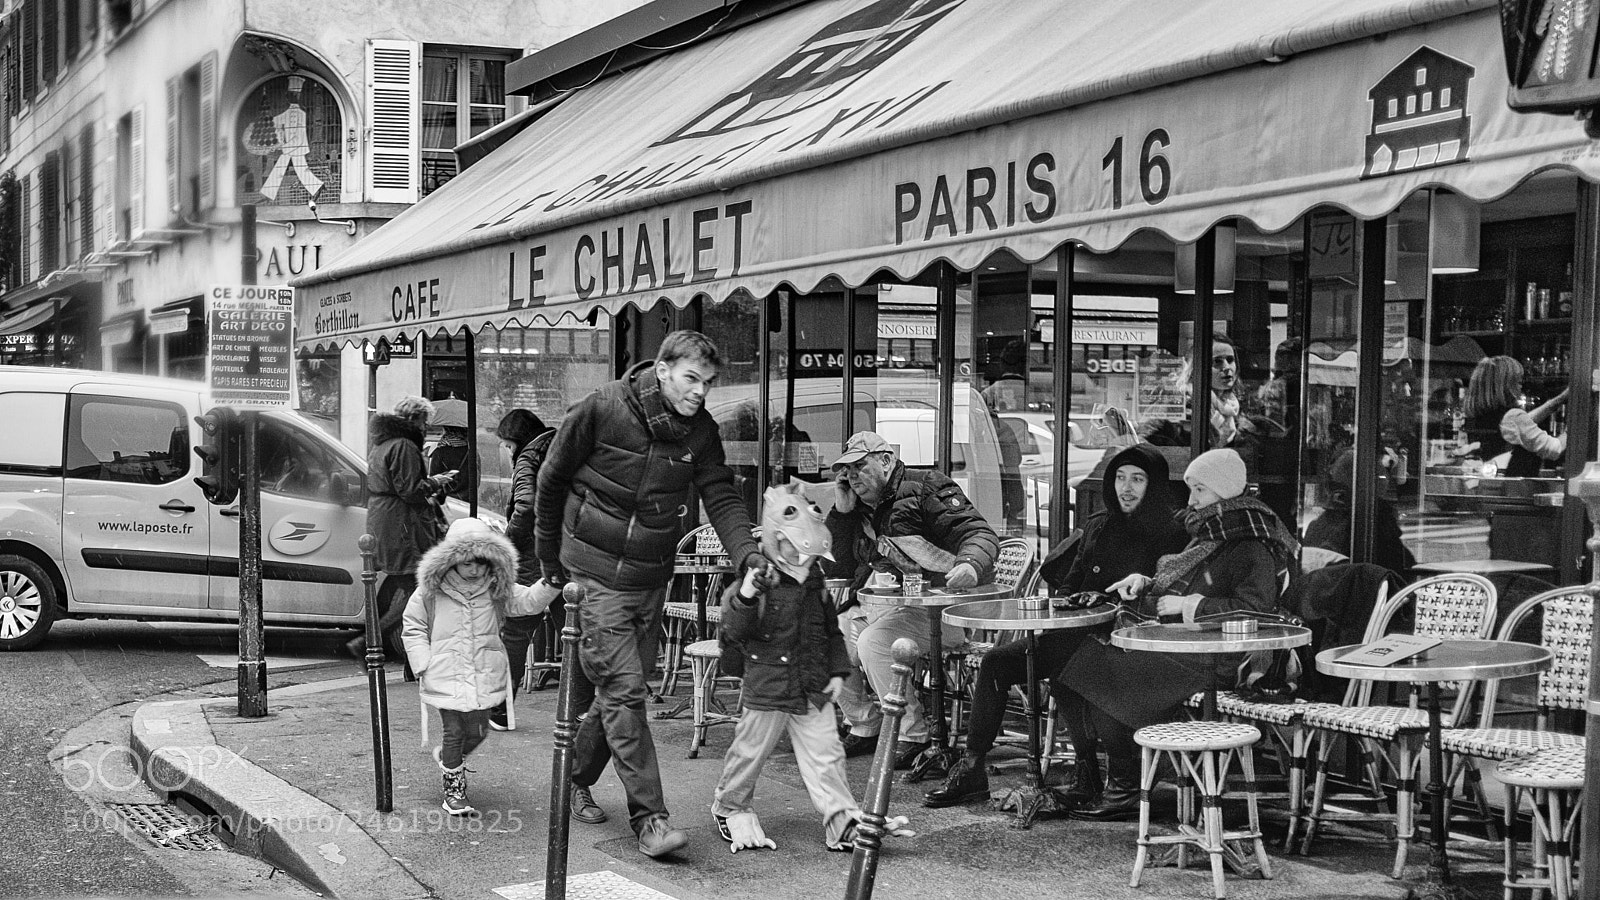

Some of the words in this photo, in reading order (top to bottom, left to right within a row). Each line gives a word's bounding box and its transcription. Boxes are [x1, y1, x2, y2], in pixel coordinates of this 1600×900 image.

[391, 278, 440, 323] CAFE
[508, 245, 547, 310] LE
[574, 200, 753, 300] CHALET
[895, 152, 1057, 245] PARIS
[1102, 127, 1171, 206] 16
[213, 288, 232, 299] CE
[237, 288, 277, 300] JOUR
[218, 311, 286, 321] GALERIE
[220, 322, 247, 331] ART
[251, 322, 286, 331] DECO
[247, 335, 270, 343] BRONZE
[1073, 330, 1146, 341] RESTAURANT
[211, 365, 244, 373] FAUTEUILS
[214, 377, 231, 386] TAPIS
[231, 377, 250, 387] RARES
[251, 378, 259, 387] ET
[97, 520, 194, 535] www.laposte.fr
